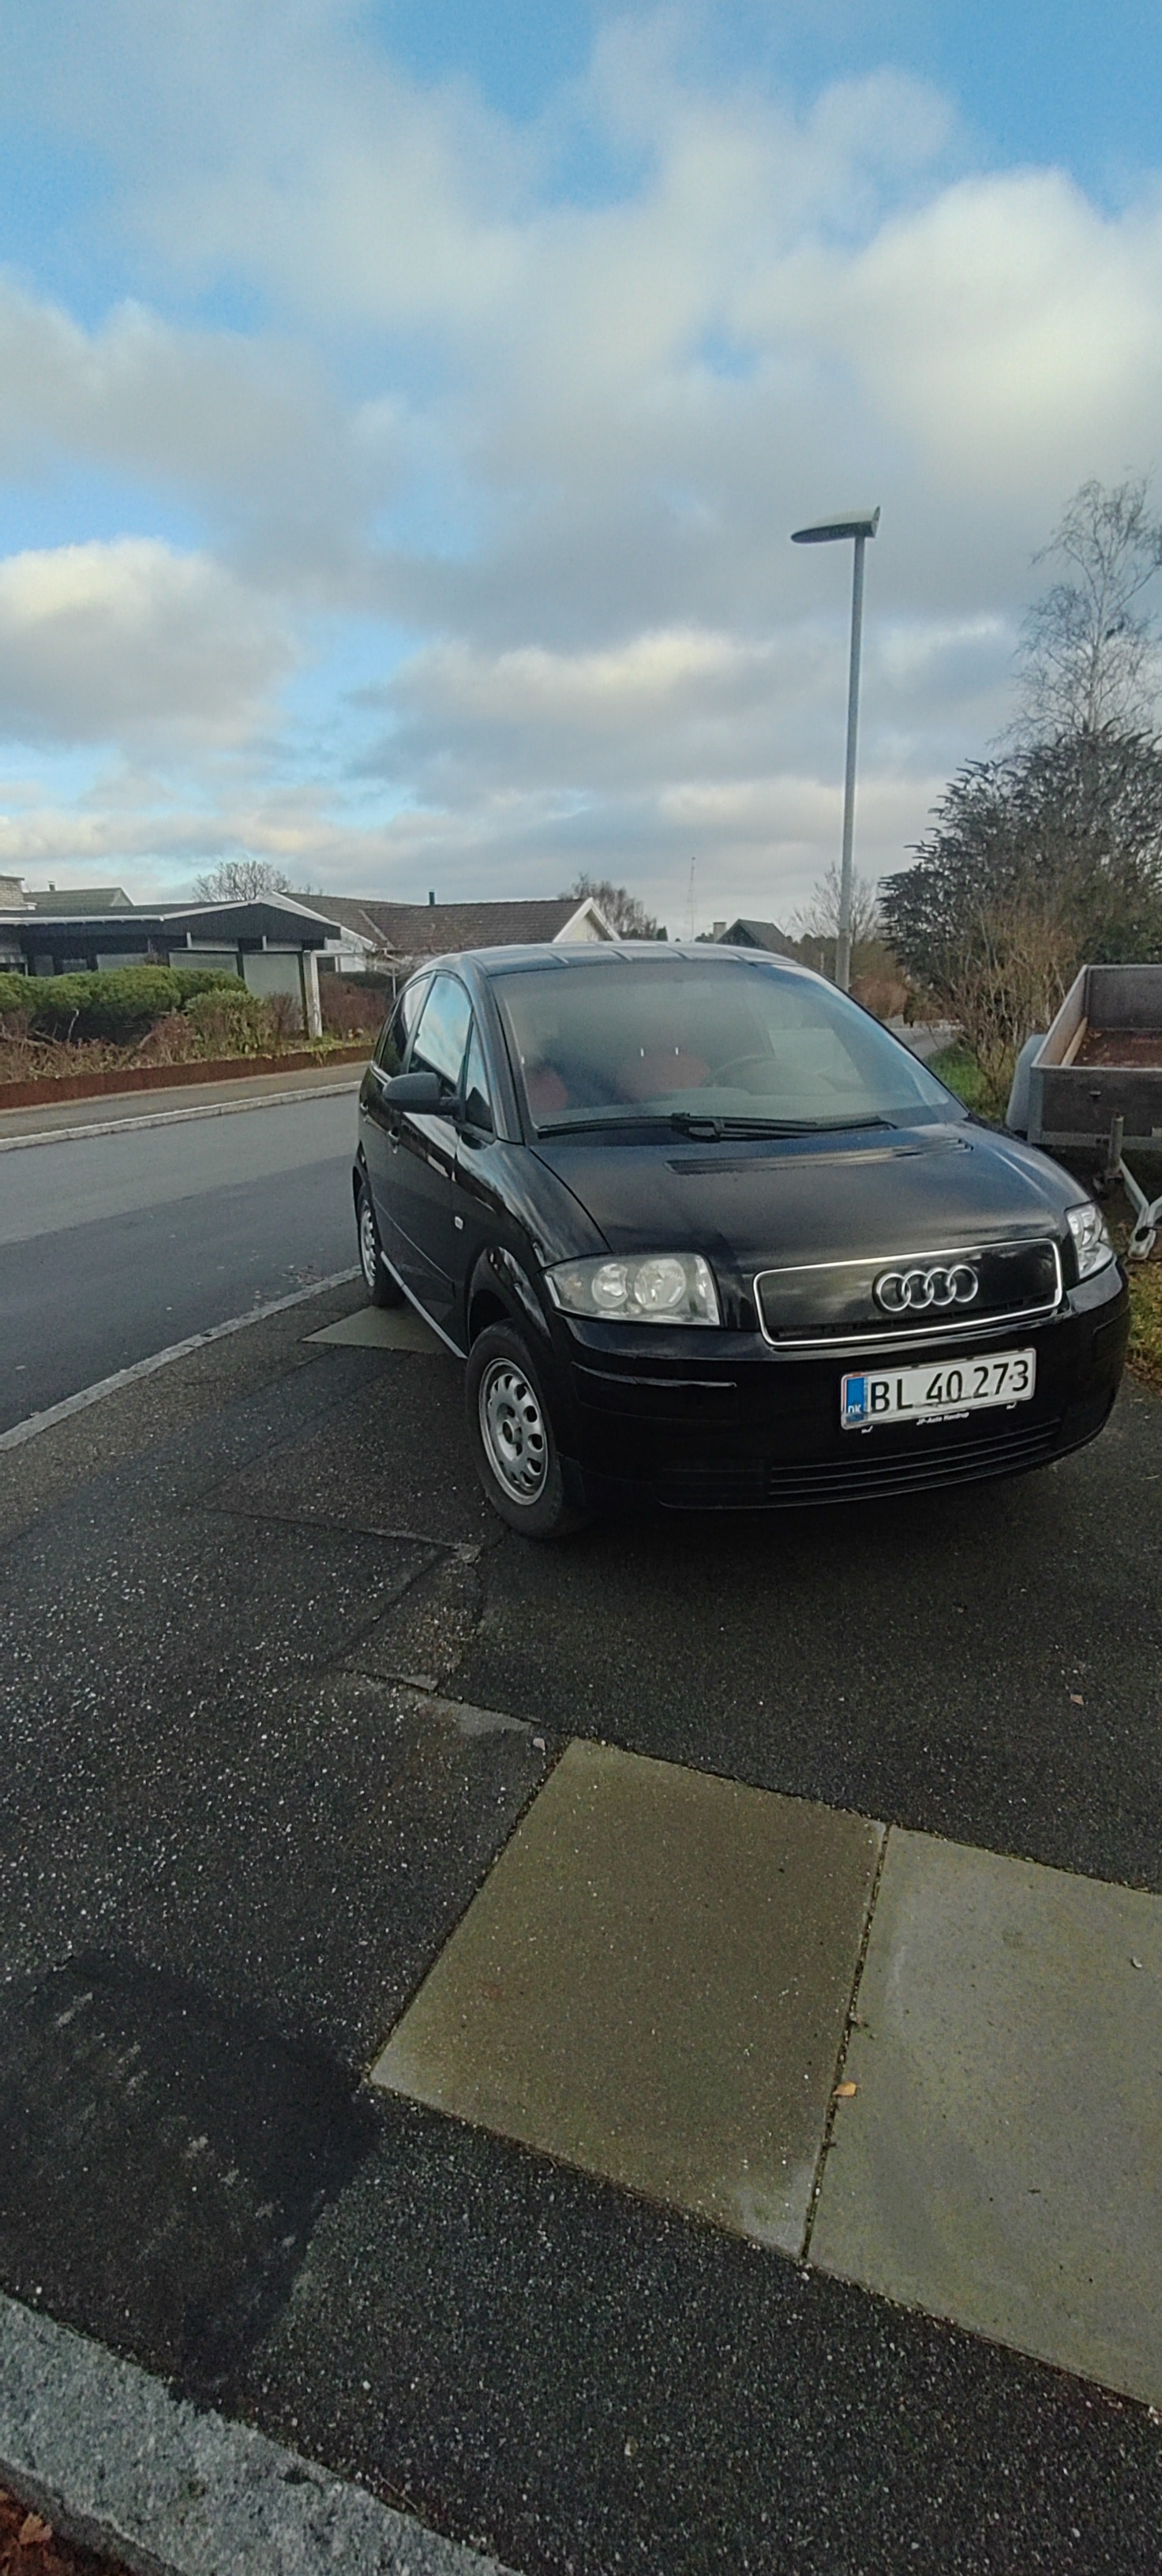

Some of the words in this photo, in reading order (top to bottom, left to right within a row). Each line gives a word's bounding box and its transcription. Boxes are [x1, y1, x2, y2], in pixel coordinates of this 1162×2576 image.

[871, 1379, 913, 1413] BL
[926, 1370, 962, 1403] 40
[973, 1360, 1029, 1398] 273
[848, 1404, 862, 1413] DK
